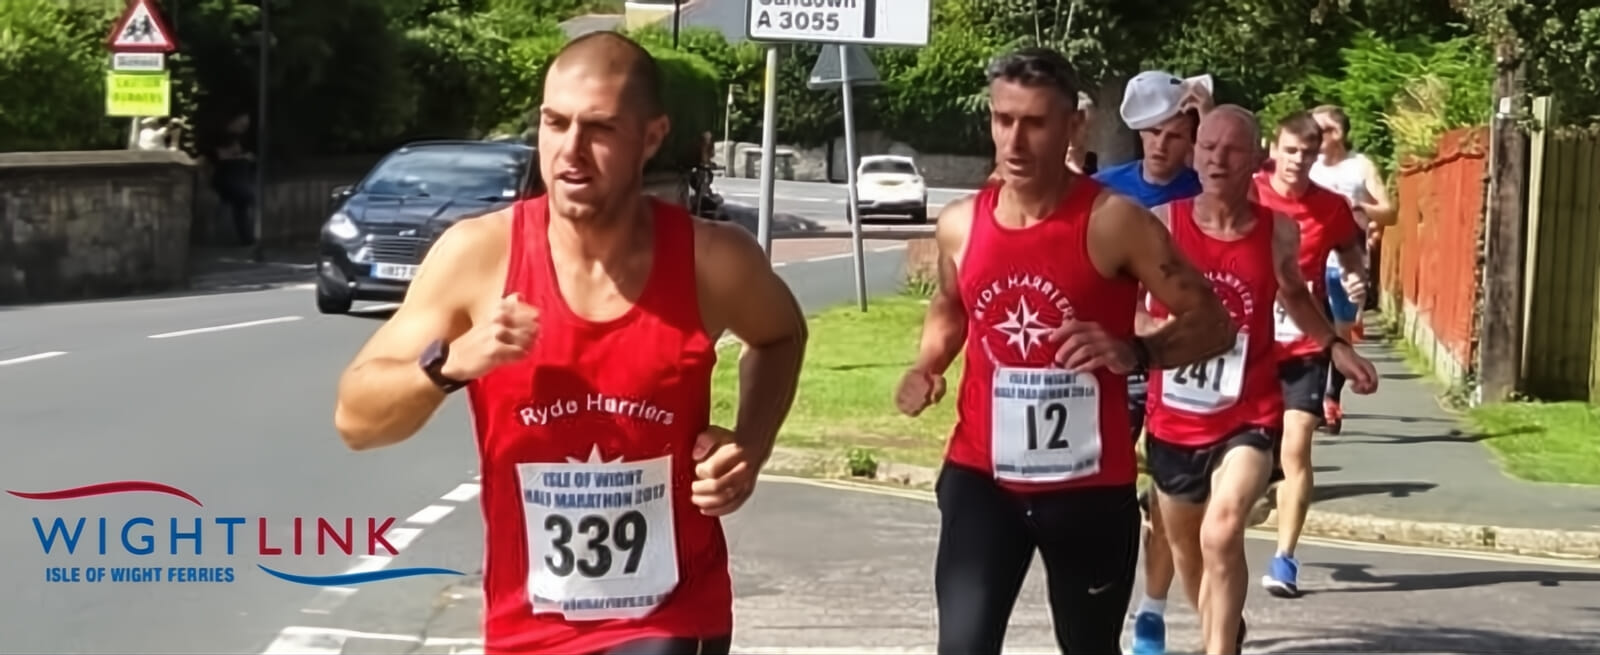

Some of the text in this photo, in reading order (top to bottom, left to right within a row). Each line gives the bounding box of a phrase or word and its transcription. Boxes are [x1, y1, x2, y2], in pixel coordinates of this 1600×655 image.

[757, 11, 840, 32] A 3055
[1026, 403, 1070, 451] 12
[573, 470, 592, 488] OF
[594, 469, 644, 488] WIGHT
[554, 490, 633, 509] MARATHON
[544, 509, 648, 578] 339
